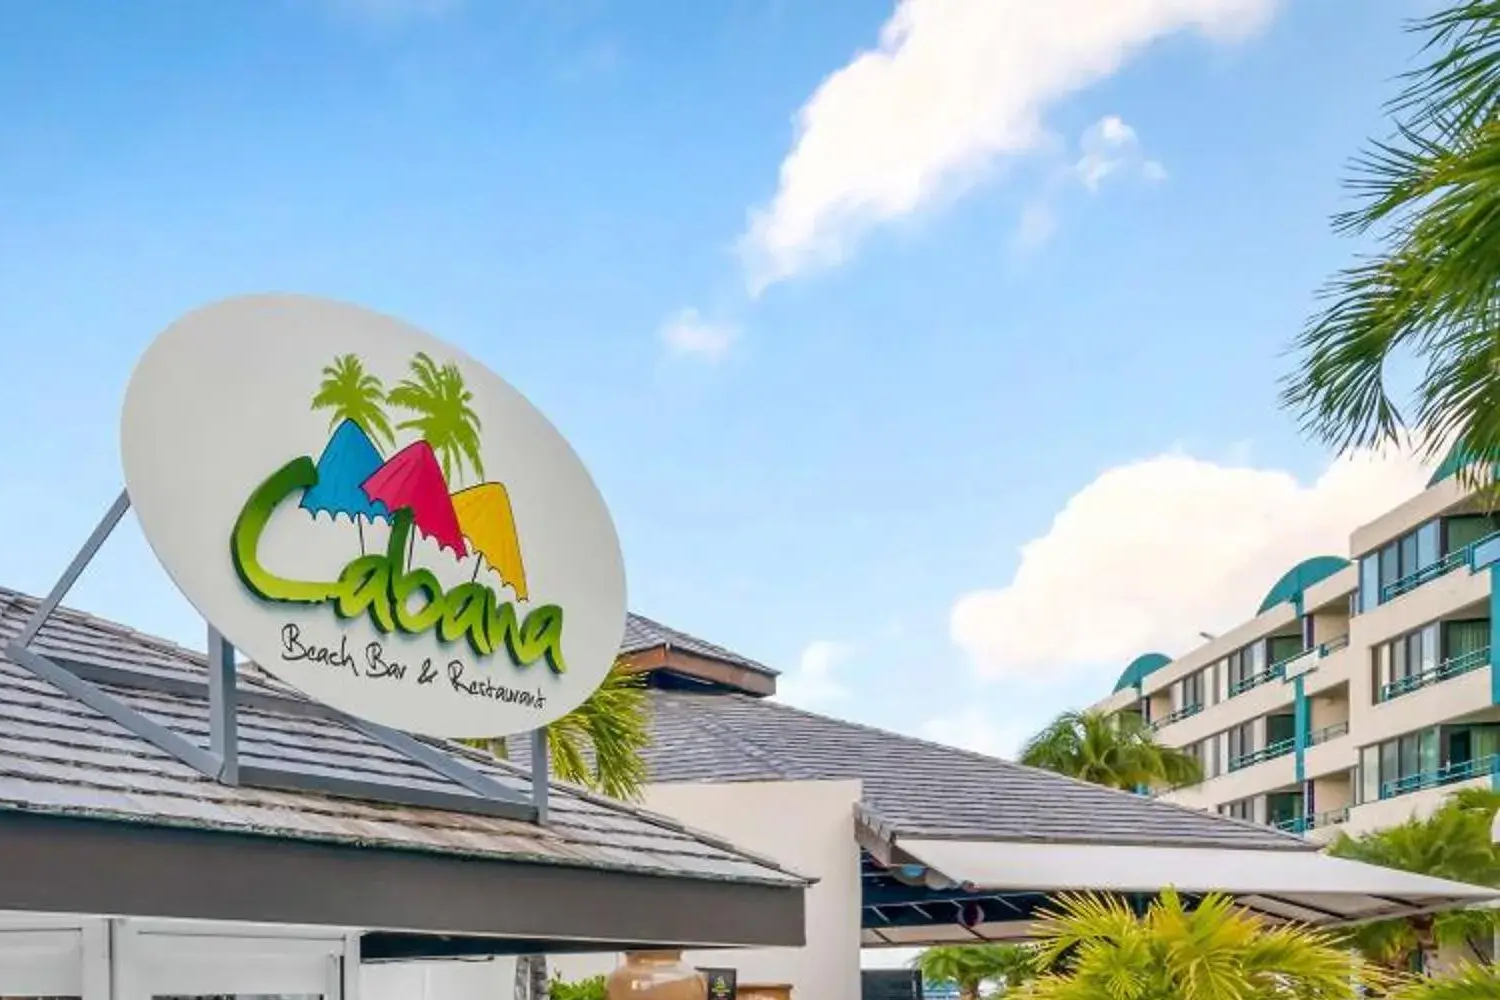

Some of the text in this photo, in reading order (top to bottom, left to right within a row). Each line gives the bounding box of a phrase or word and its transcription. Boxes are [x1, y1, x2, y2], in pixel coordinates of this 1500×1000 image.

[230, 456, 565, 674] Cabana
[282, 624, 547, 709] Beach Bar & Restaurant
